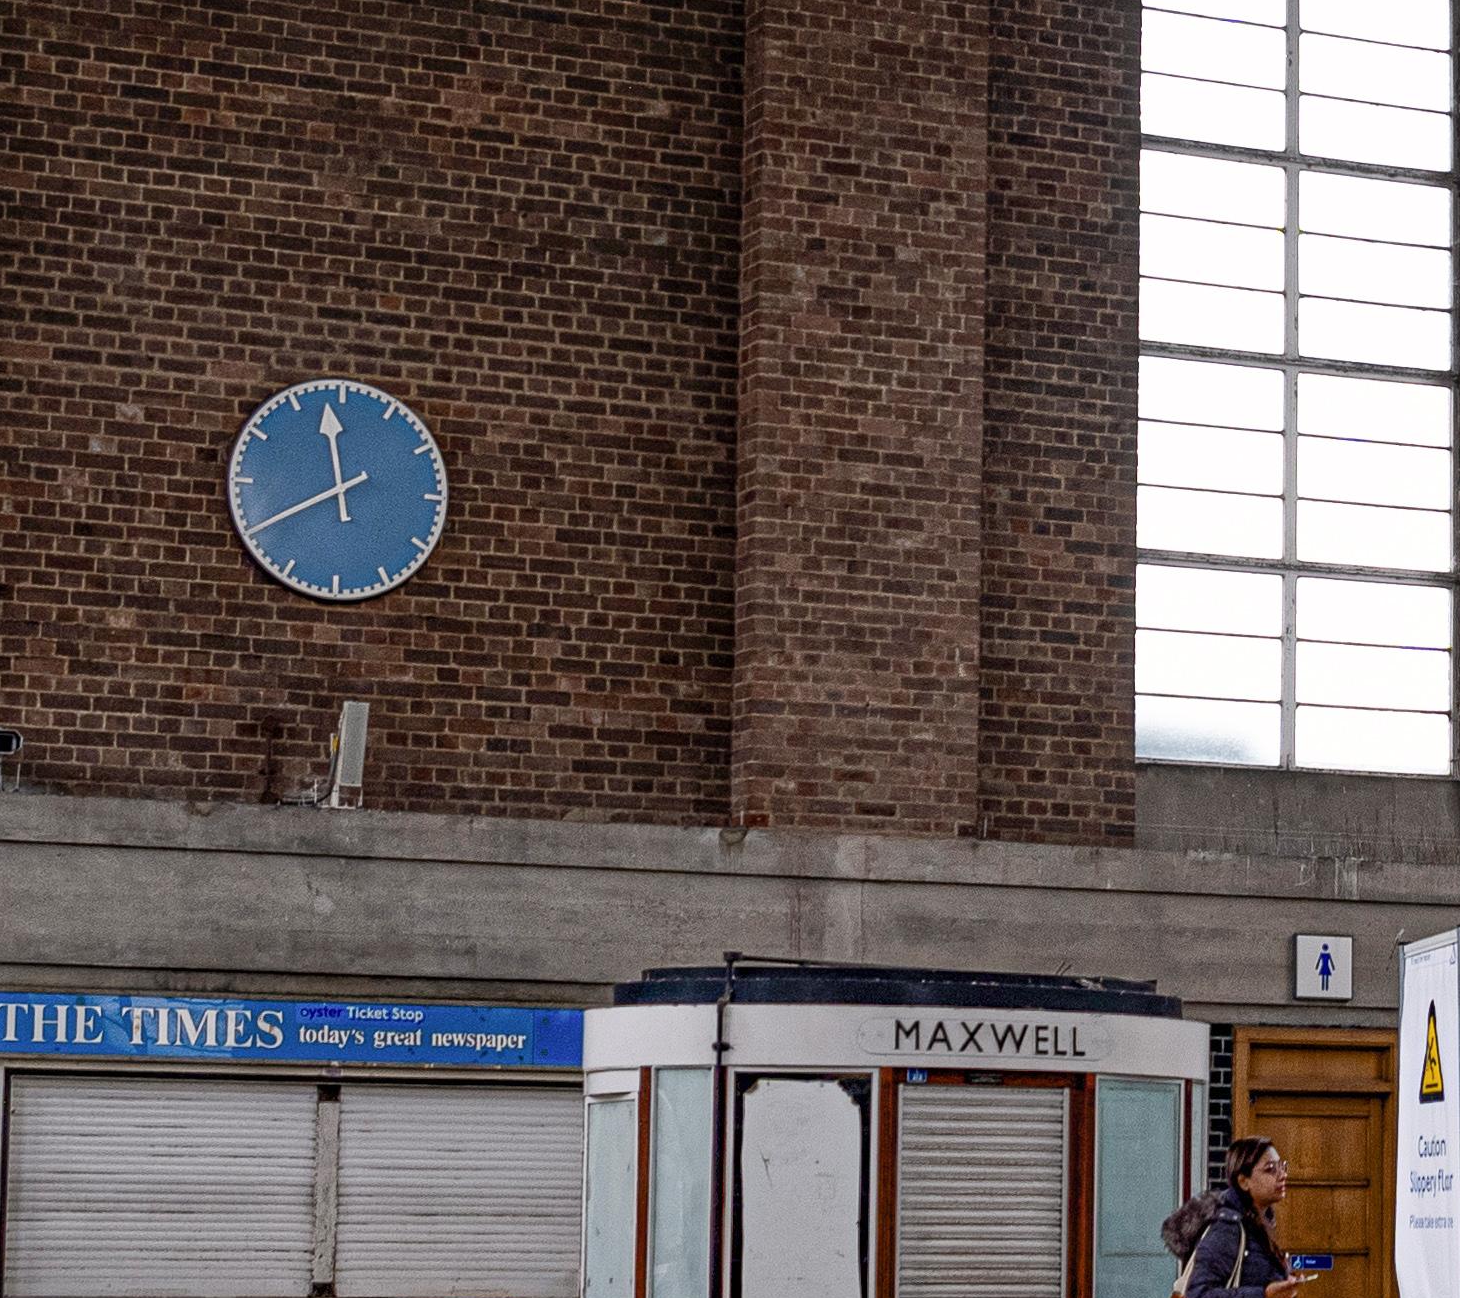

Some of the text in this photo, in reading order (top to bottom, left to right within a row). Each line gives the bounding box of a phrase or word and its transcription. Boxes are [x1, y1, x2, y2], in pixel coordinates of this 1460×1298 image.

[121, 1006, 284, 1049] TIMES
[301, 1004, 424, 1023] oyster Ticket Stop
[299, 1025, 527, 1052] today's great newspaper
[894, 1019, 1086, 1057] MAXWELL
